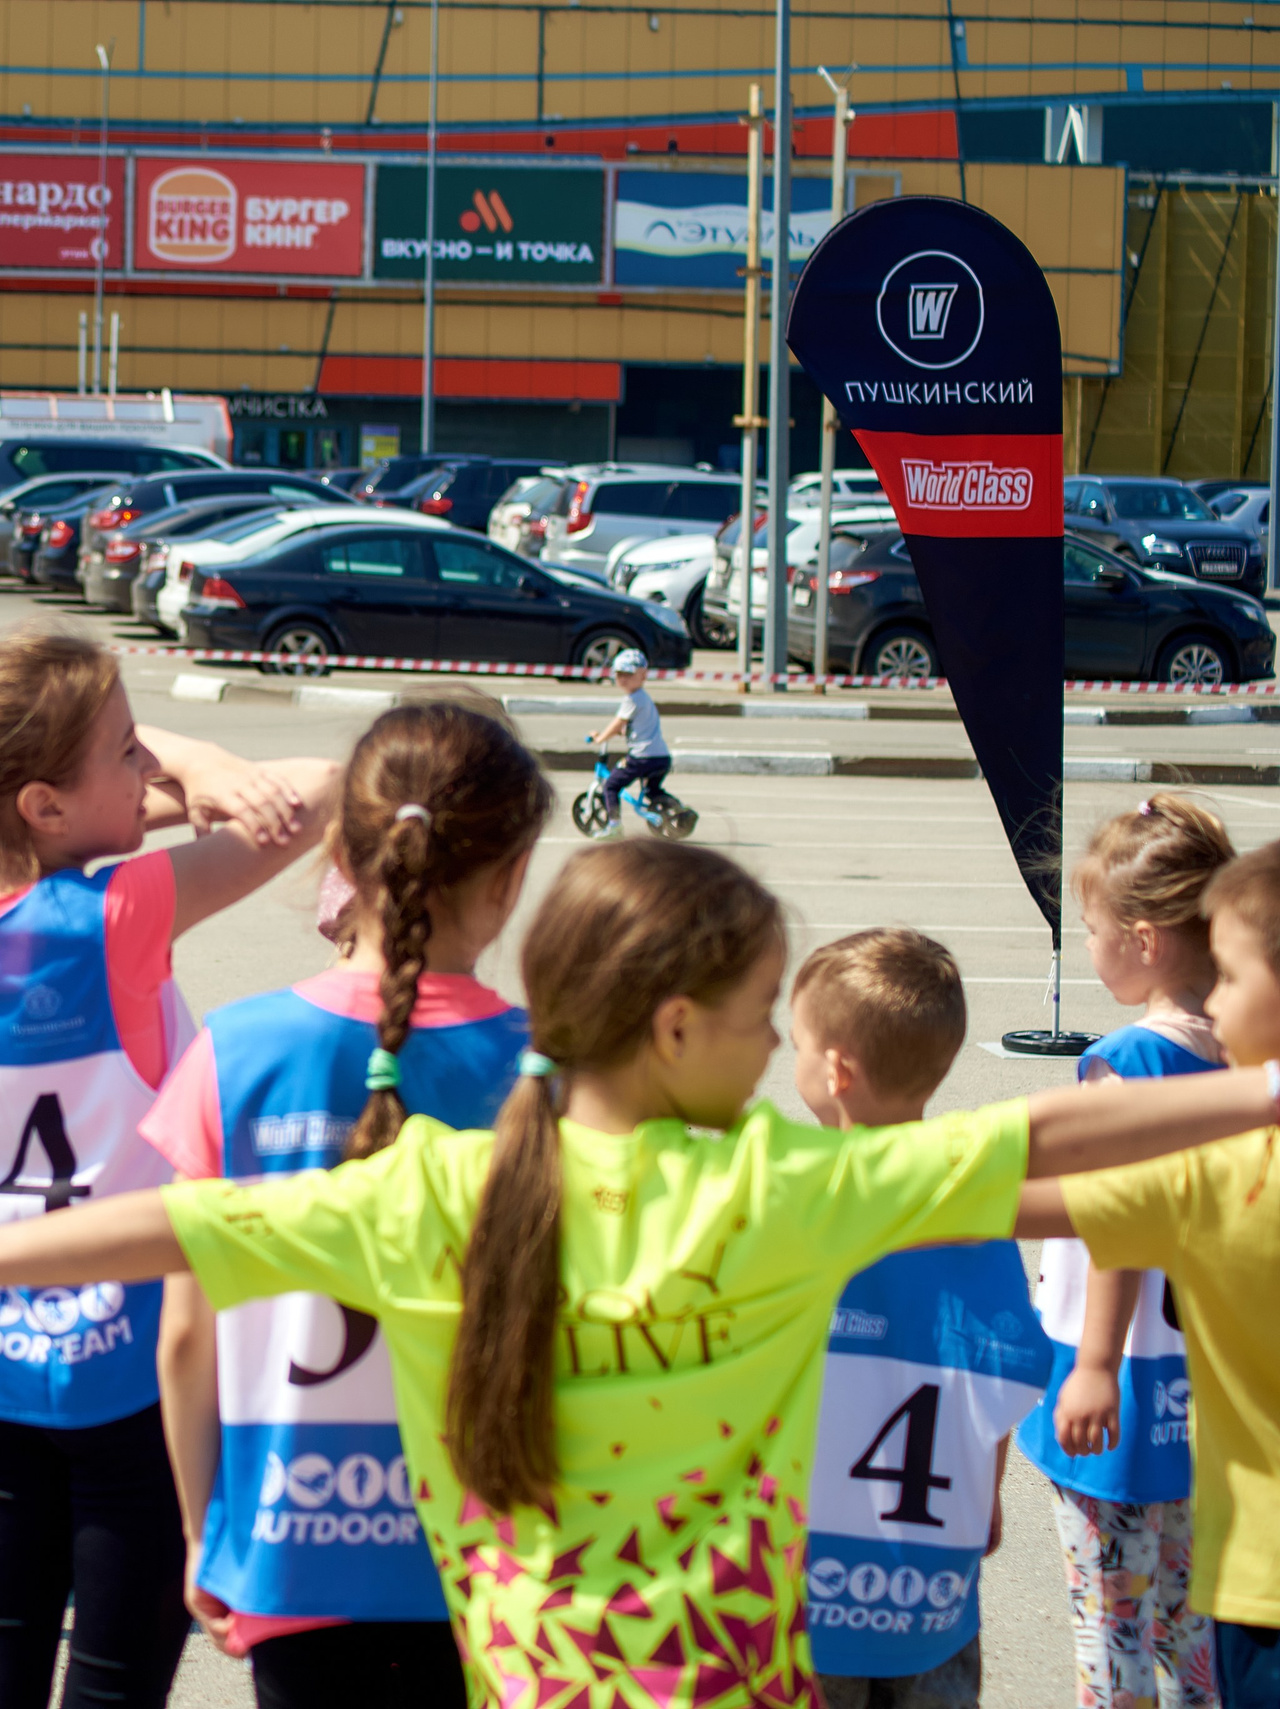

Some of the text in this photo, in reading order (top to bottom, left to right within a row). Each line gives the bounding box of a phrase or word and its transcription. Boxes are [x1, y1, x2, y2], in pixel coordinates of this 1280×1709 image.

[156, 201, 230, 216] BURGER
[245, 198, 349, 224] БУРГЕР
[156, 218, 230, 242] KING
[245, 223, 319, 248] КИНГ
[381, 238, 472, 260] ВКУСНО
[495, 240, 513, 261] И
[516, 241, 594, 263] ТОЧКА
[845, 378, 1034, 404] ПУШКИНСКИЙ
[850, 1384, 952, 1528] 4
